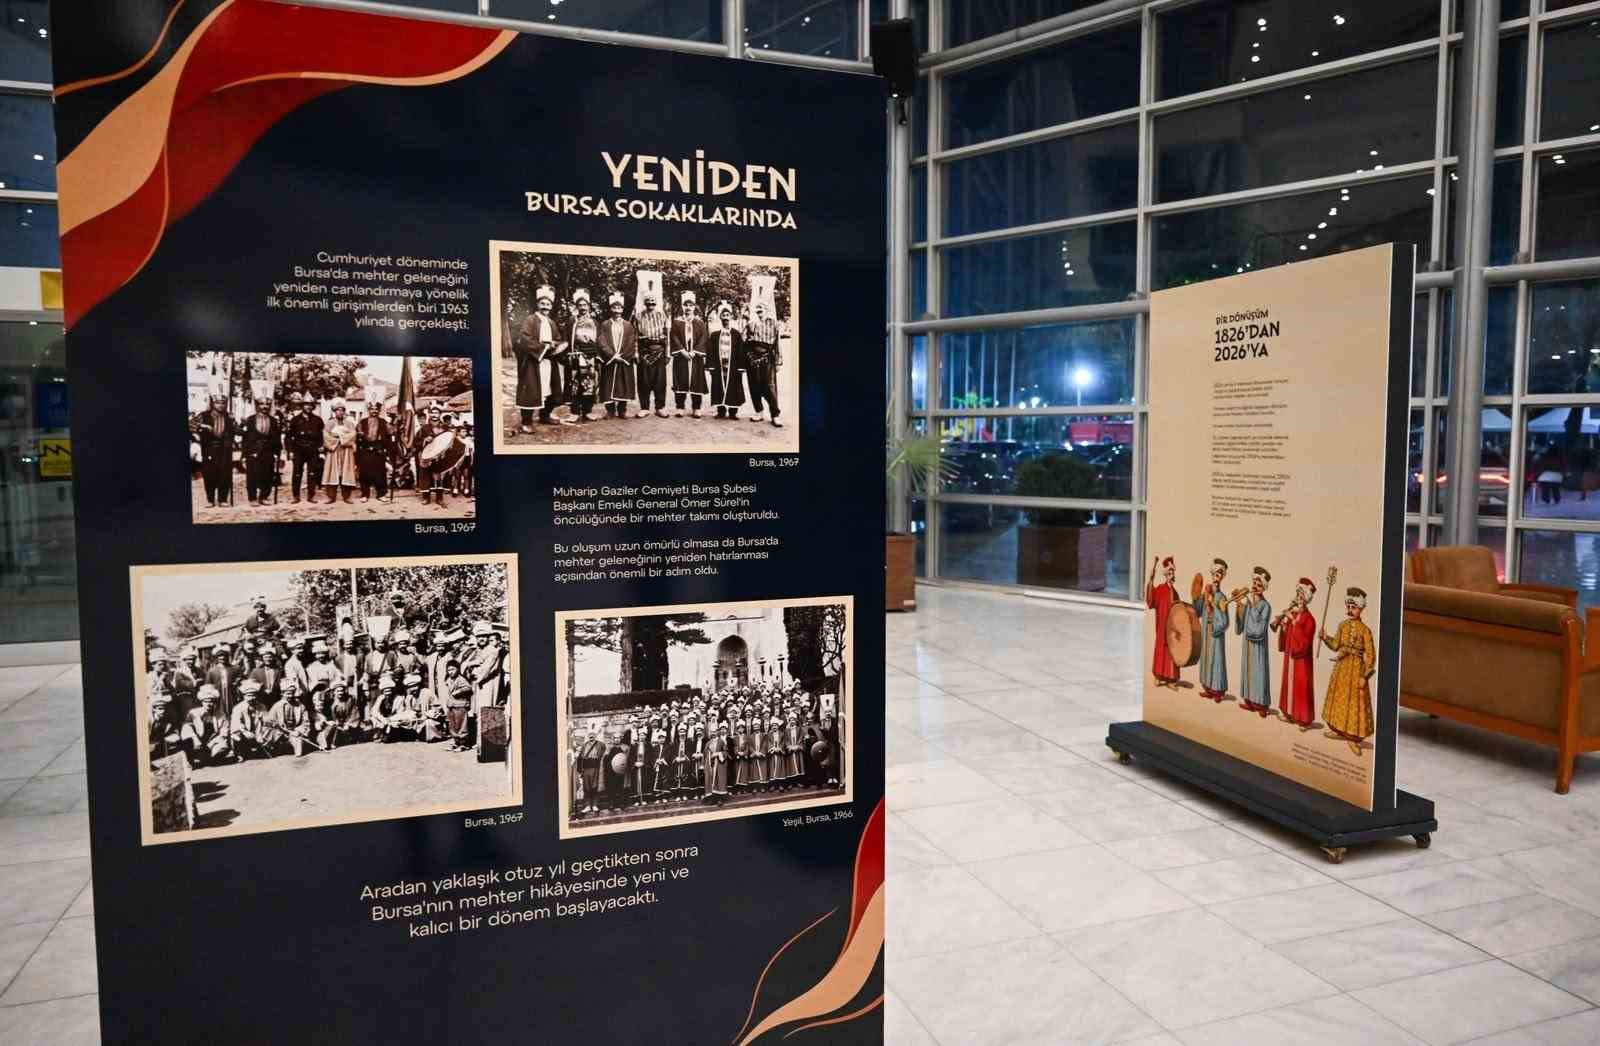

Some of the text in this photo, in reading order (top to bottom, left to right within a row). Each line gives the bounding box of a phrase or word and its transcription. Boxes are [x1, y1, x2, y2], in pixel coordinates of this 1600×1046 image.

[601, 150, 797, 201] YENİDEN
[525, 192, 797, 229] BURSA SOKAKLARINDA
[317, 251, 468, 269] Cumhuriyet döneminde
[294, 266, 469, 286] Bursa'da mehter geleneğini
[273, 282, 469, 301] yeniden canlandırmaya yönelik
[267, 296, 469, 315] ilk önemli girişimlerden biri 1963
[355, 316, 469, 332] yılında gerçekleşti.
[1229, 308, 1269, 322] DÖNÜŞÜM
[1215, 321, 1280, 344] 1826'DAN
[1214, 342, 1268, 362] 2026'YA
[749, 457, 799, 467] Bursa, 1967
[553, 484, 757, 499] Muharip Gaziler Cemiyeti Bursa Şubesi
[553, 497, 750, 513] Başkanı Emekli General Ömer Sürel'in
[553, 510, 780, 527] öncülüğünde bir mehter takımı oluşturuldu.
[415, 522, 476, 534] Bursa, 1967
[554, 536, 779, 555] Bu oluşum uzun ömürlü olmasa da Bursa'da
[554, 551, 769, 568] mehter geleneğinin yeniden hatırlanması
[554, 565, 719, 583] açısından önemli bir adım oldu.
[464, 812, 523, 828] Bursa, 1967
[360, 846, 699, 900] Aradan yaklaşık otuz yıl geçtikten sonra
[372, 867, 689, 921] Bursa'nın mehter hikâyesinde yeni ve
[409, 890, 659, 938] kalıcı bir dönem başlayacaktı.
